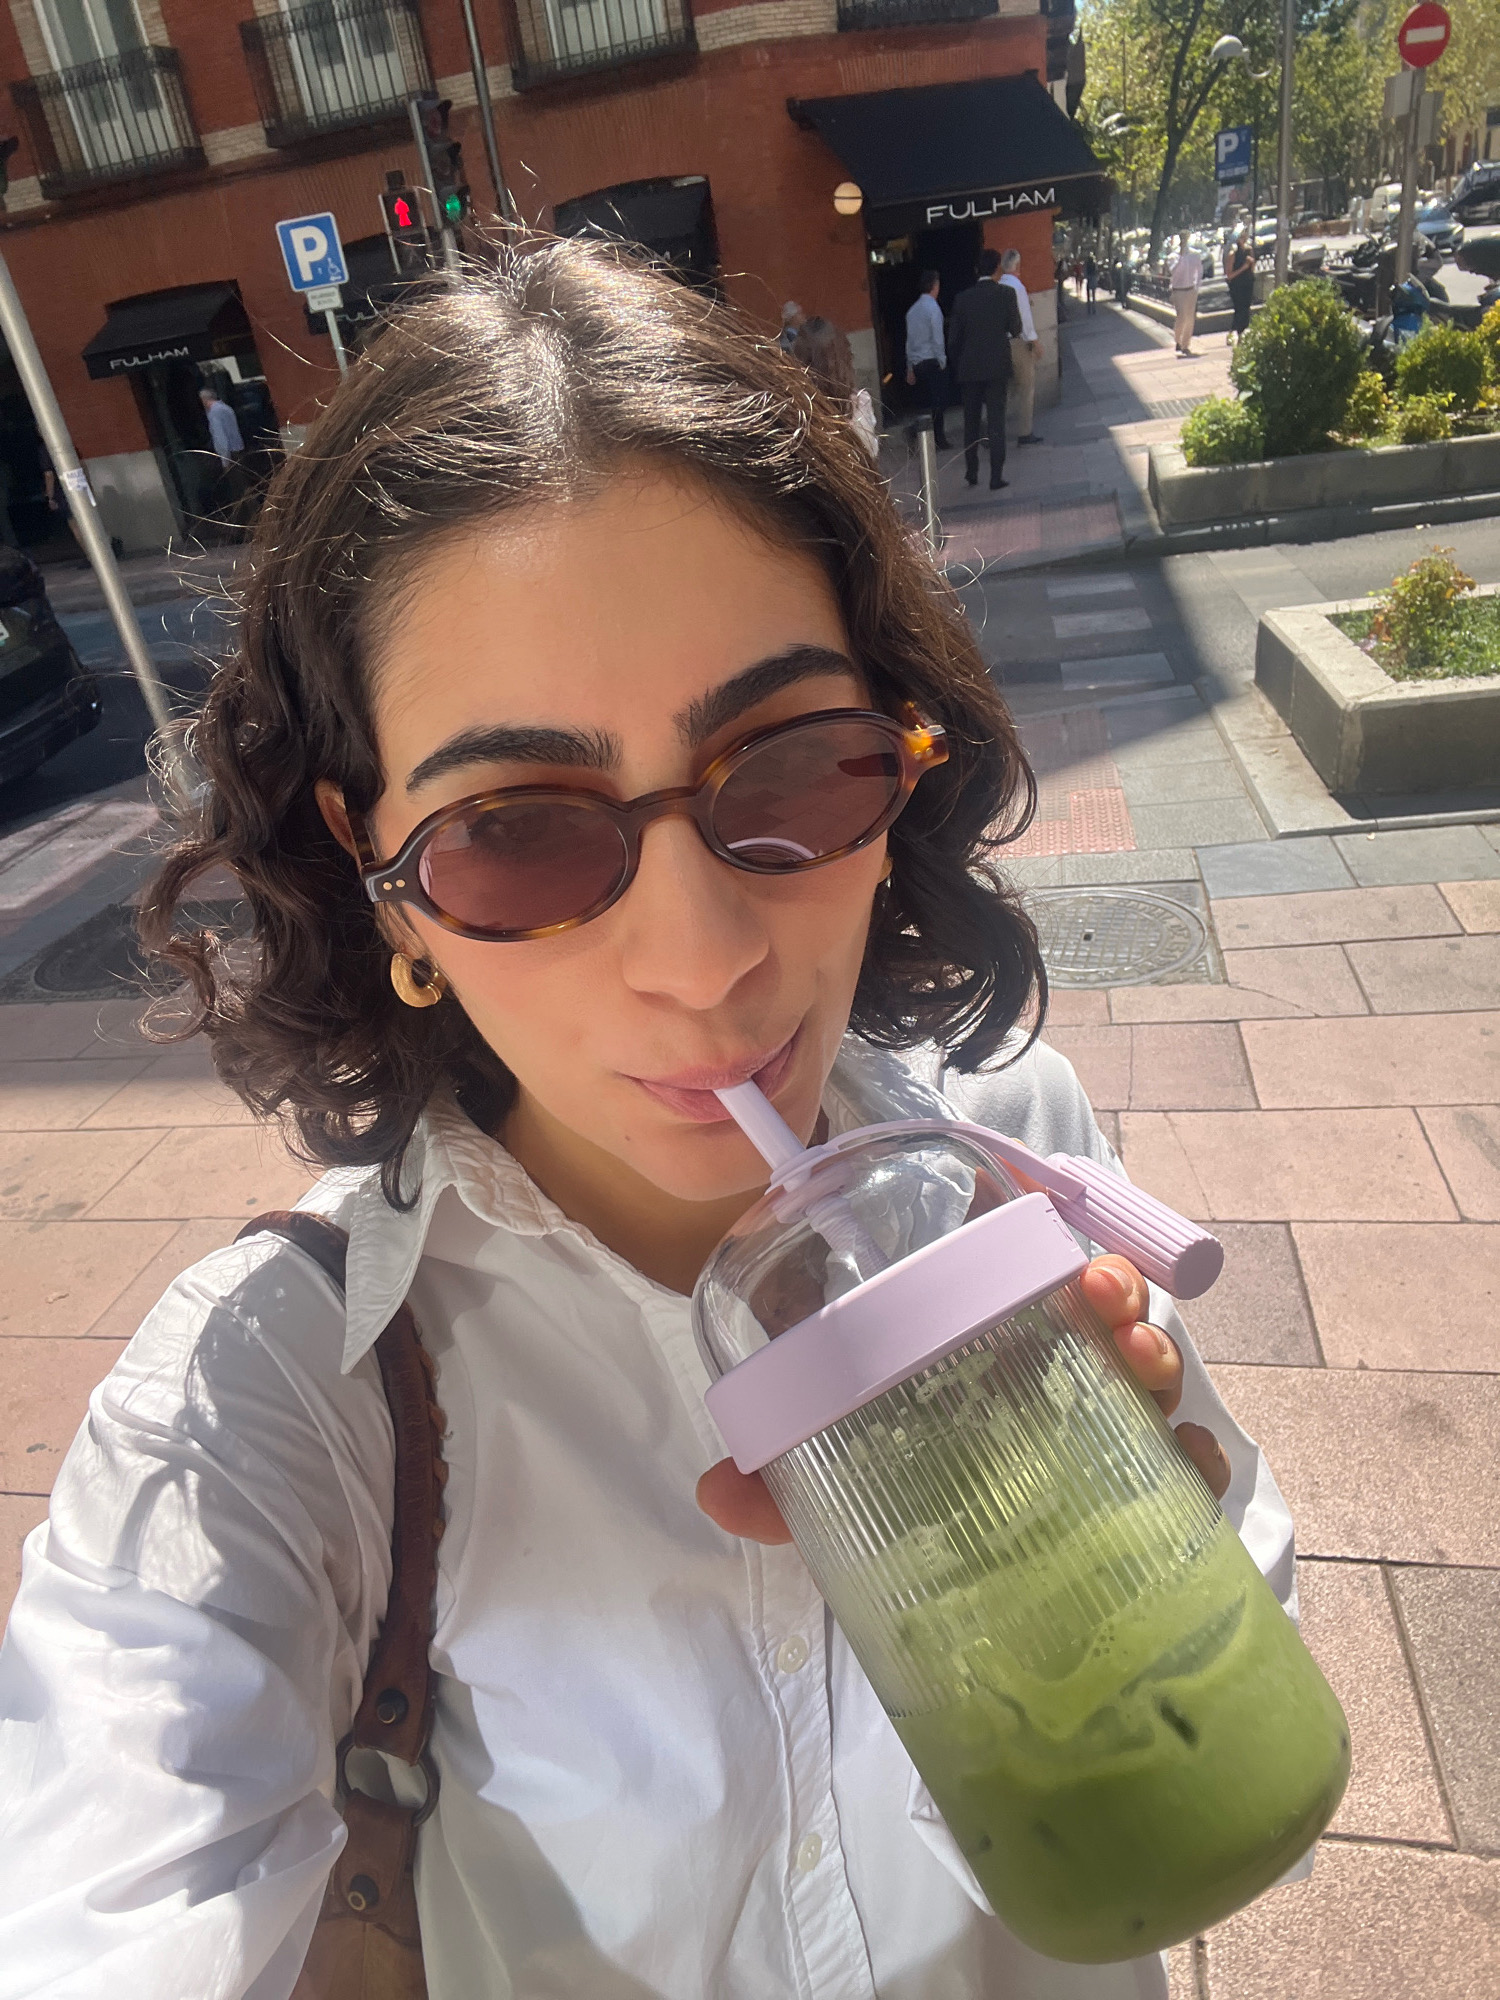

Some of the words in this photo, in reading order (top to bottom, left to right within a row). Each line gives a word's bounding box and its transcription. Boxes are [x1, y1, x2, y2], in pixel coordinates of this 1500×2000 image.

[1217, 131, 1239, 164] P
[926, 187, 1055, 225] FULHAM
[289, 225, 328, 282] P
[109, 346, 189, 370] FULHAM
